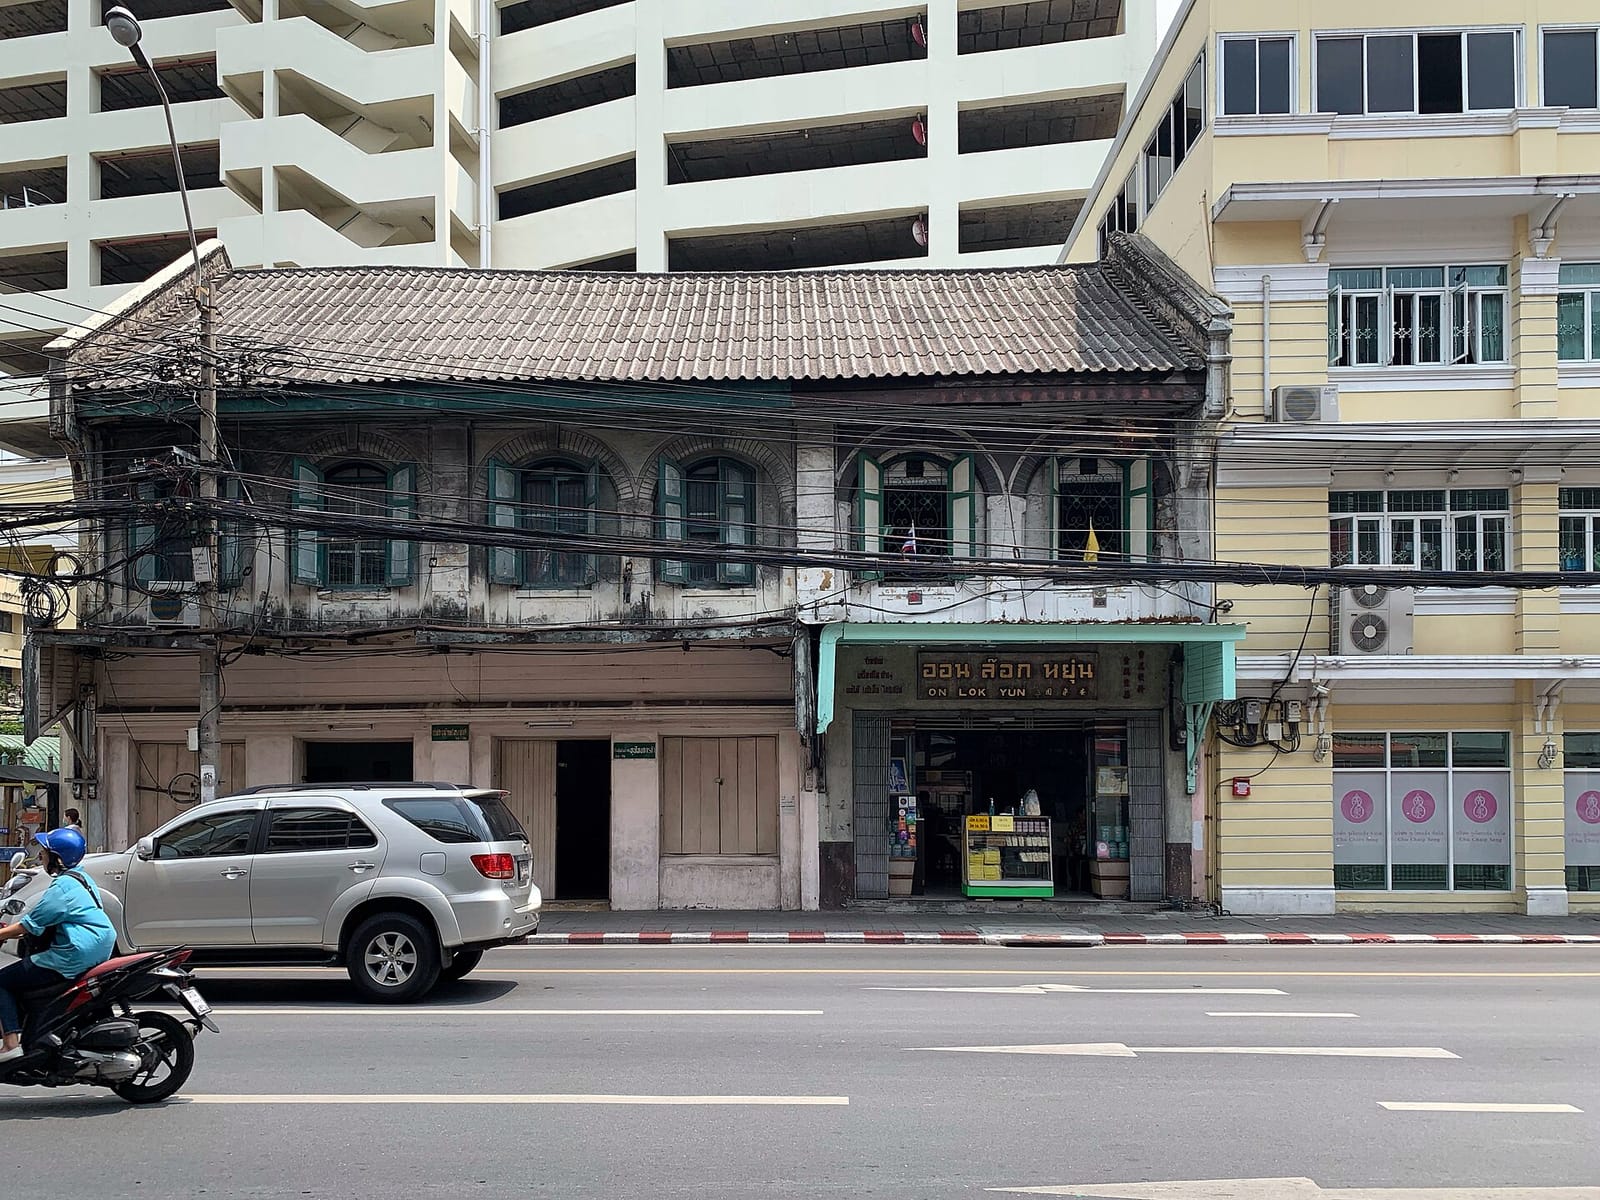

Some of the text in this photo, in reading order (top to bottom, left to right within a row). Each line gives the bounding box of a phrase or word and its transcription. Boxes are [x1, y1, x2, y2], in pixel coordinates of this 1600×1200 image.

[923, 663, 970, 678] ออน
[1043, 658, 1093, 684] หยุ่น
[928, 688, 947, 697] ON
[958, 688, 986, 697] LOK
[999, 688, 1026, 697] YUN
